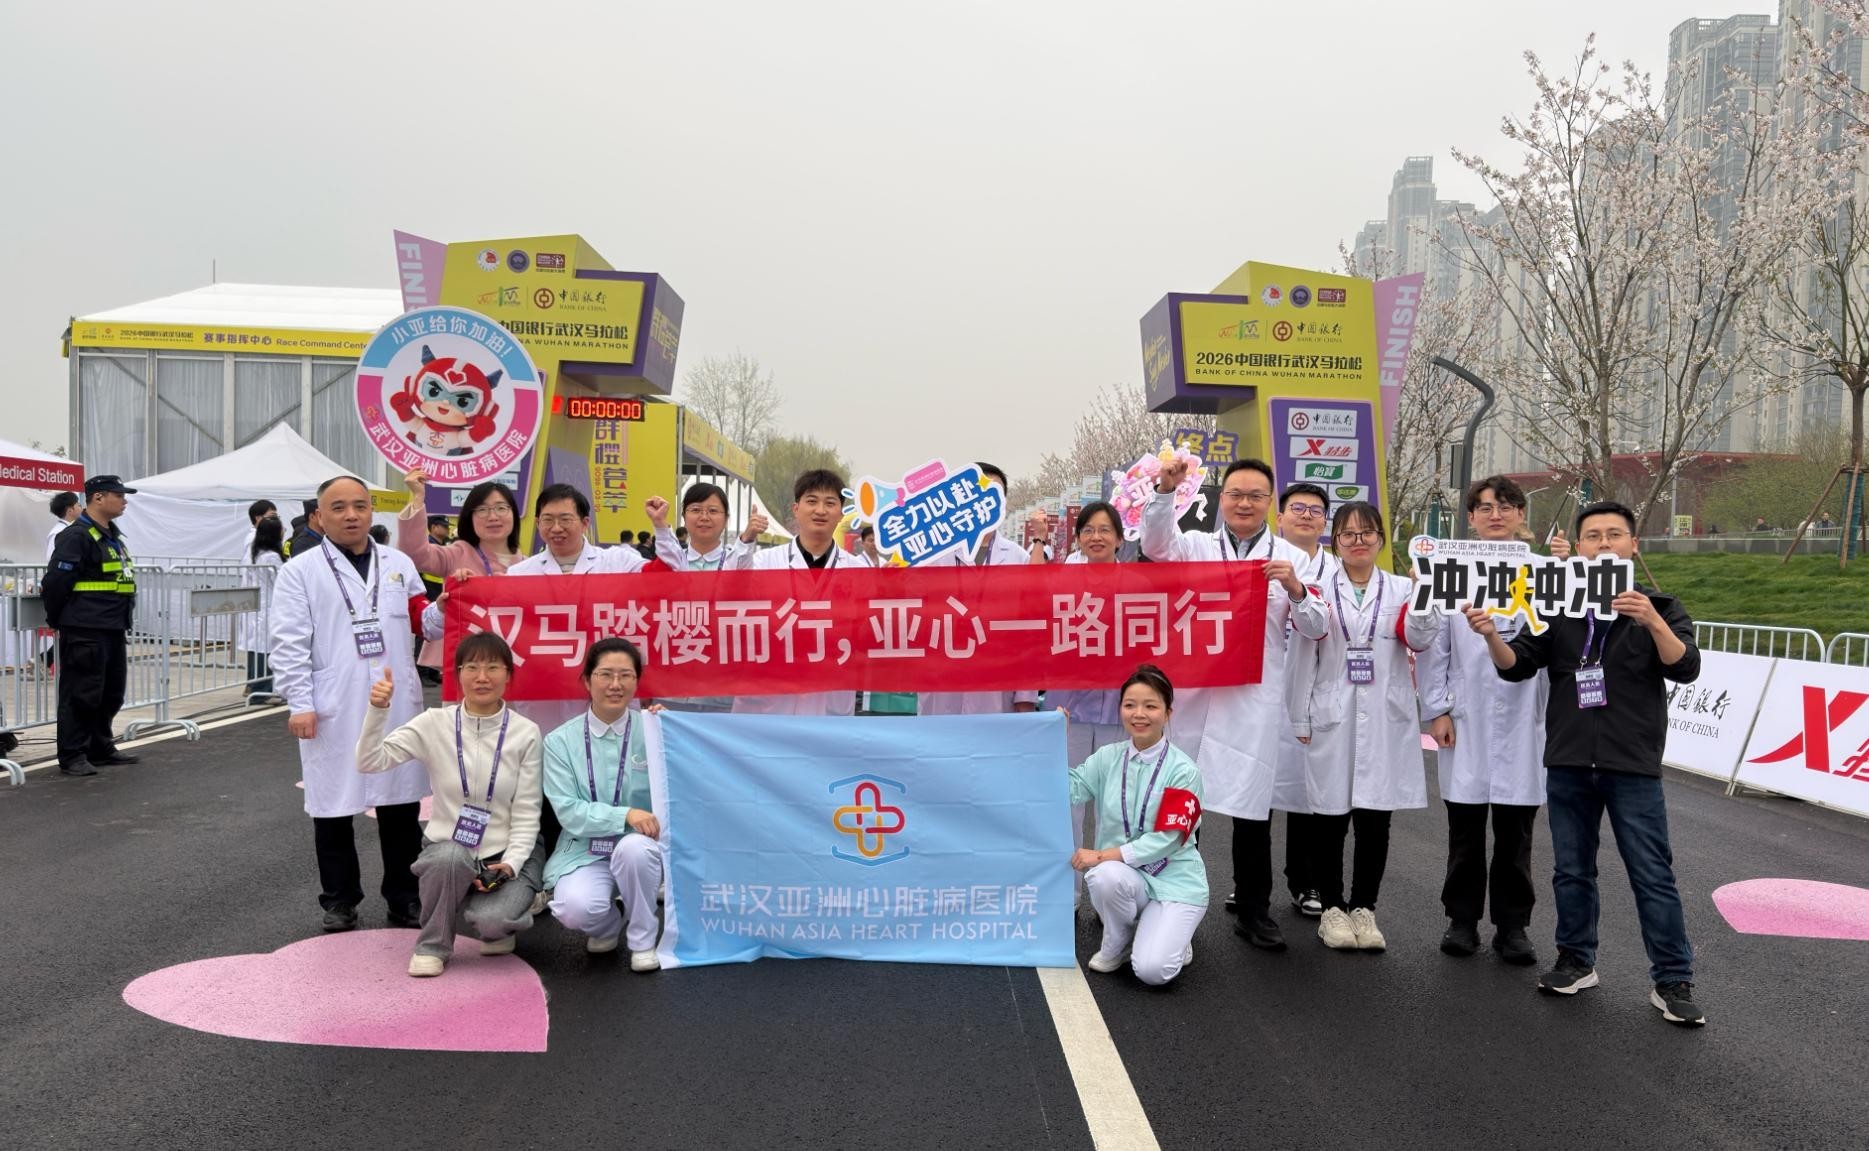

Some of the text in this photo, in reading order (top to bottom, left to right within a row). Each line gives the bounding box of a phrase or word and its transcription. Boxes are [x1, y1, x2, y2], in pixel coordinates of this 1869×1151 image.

[399, 243, 427, 312] FINI
[203, 332, 272, 345] 赛事指挥中心
[276, 338, 298, 347] Race
[300, 339, 341, 348] Command
[391, 315, 513, 358] 小亚给你加油！
[573, 340, 629, 349] MARATHON
[1379, 285, 1418, 387] FINISH
[1196, 351, 1362, 371] 2026中国银行武汉马拉松
[1271, 370, 1306, 378] WUHAN
[1308, 371, 1362, 380] MARATHON
[570, 400, 642, 419] 00:00:00
[369, 422, 529, 479] 武汉亚洲心脏病医院
[0, 464, 75, 485] edical Station
[883, 478, 979, 541] 全力以赴
[903, 496, 996, 560] 亚心守护
[1438, 541, 1527, 553] 武汉亚洲心脏病医院
[1414, 557, 1627, 615] 冲冲冲冲
[1667, 717, 1719, 739] NK OF CHINA
[700, 883, 1038, 917] 武汉亚洲心脏病医院
[700, 917, 1037, 940] WUHAN ASIA HEART HOSPITAL
